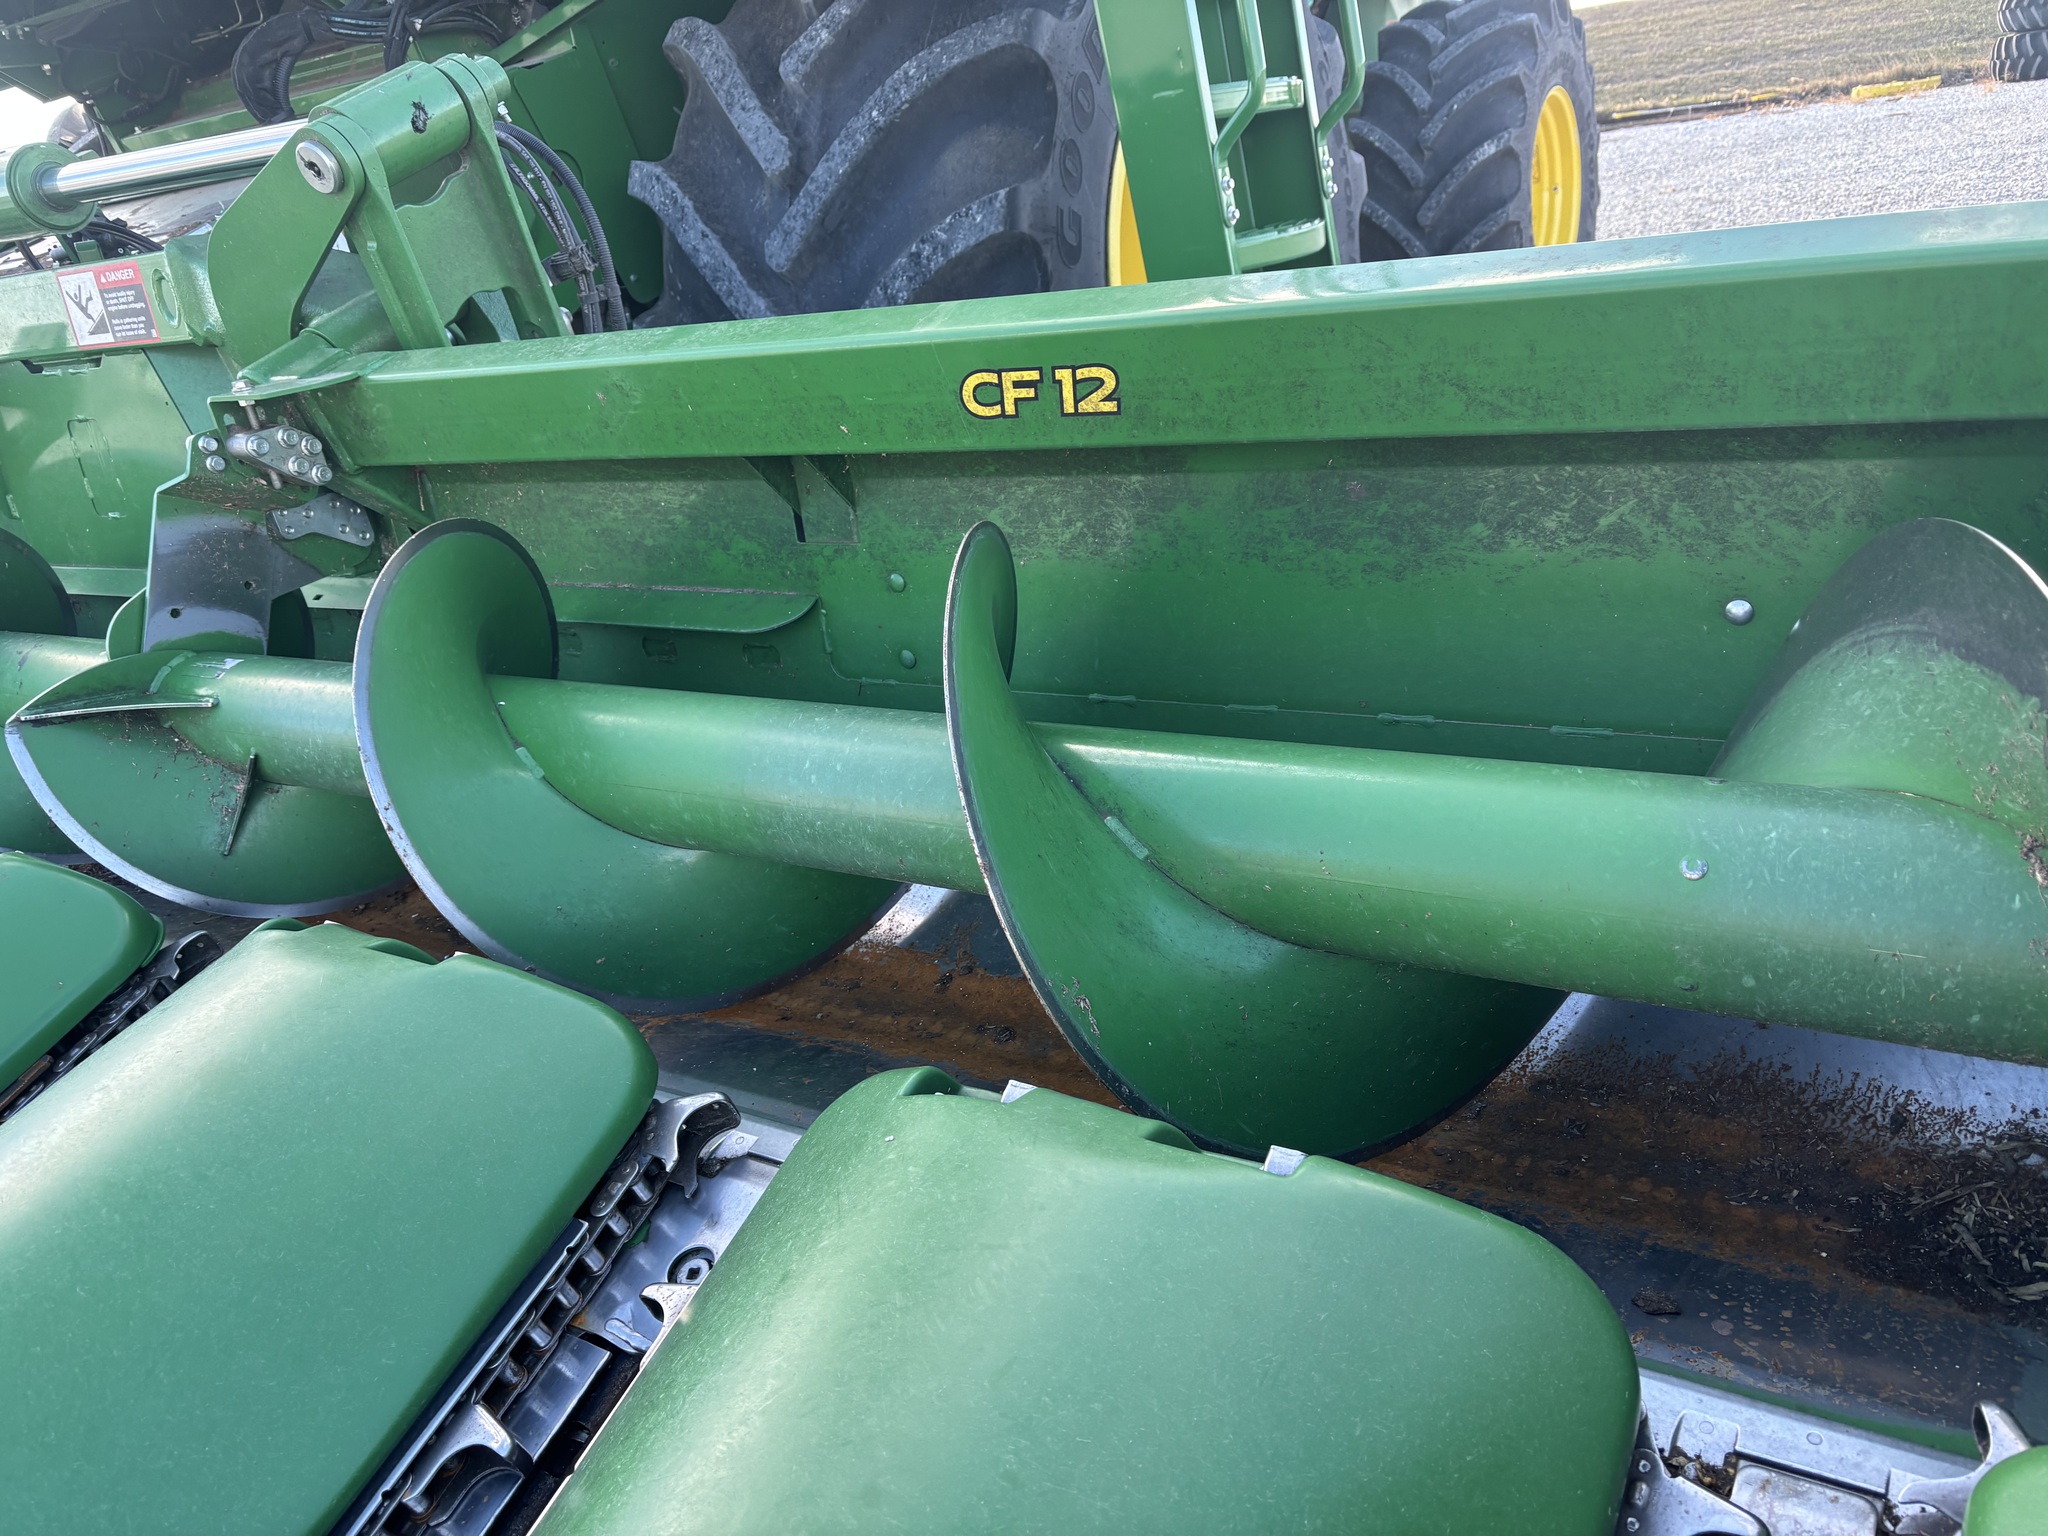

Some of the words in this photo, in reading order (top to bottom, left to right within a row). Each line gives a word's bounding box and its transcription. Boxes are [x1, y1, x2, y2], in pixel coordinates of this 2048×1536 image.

[105, 268, 135, 282] DANGER
[959, 366, 1044, 420] CF
[1051, 362, 1122, 418] 12
